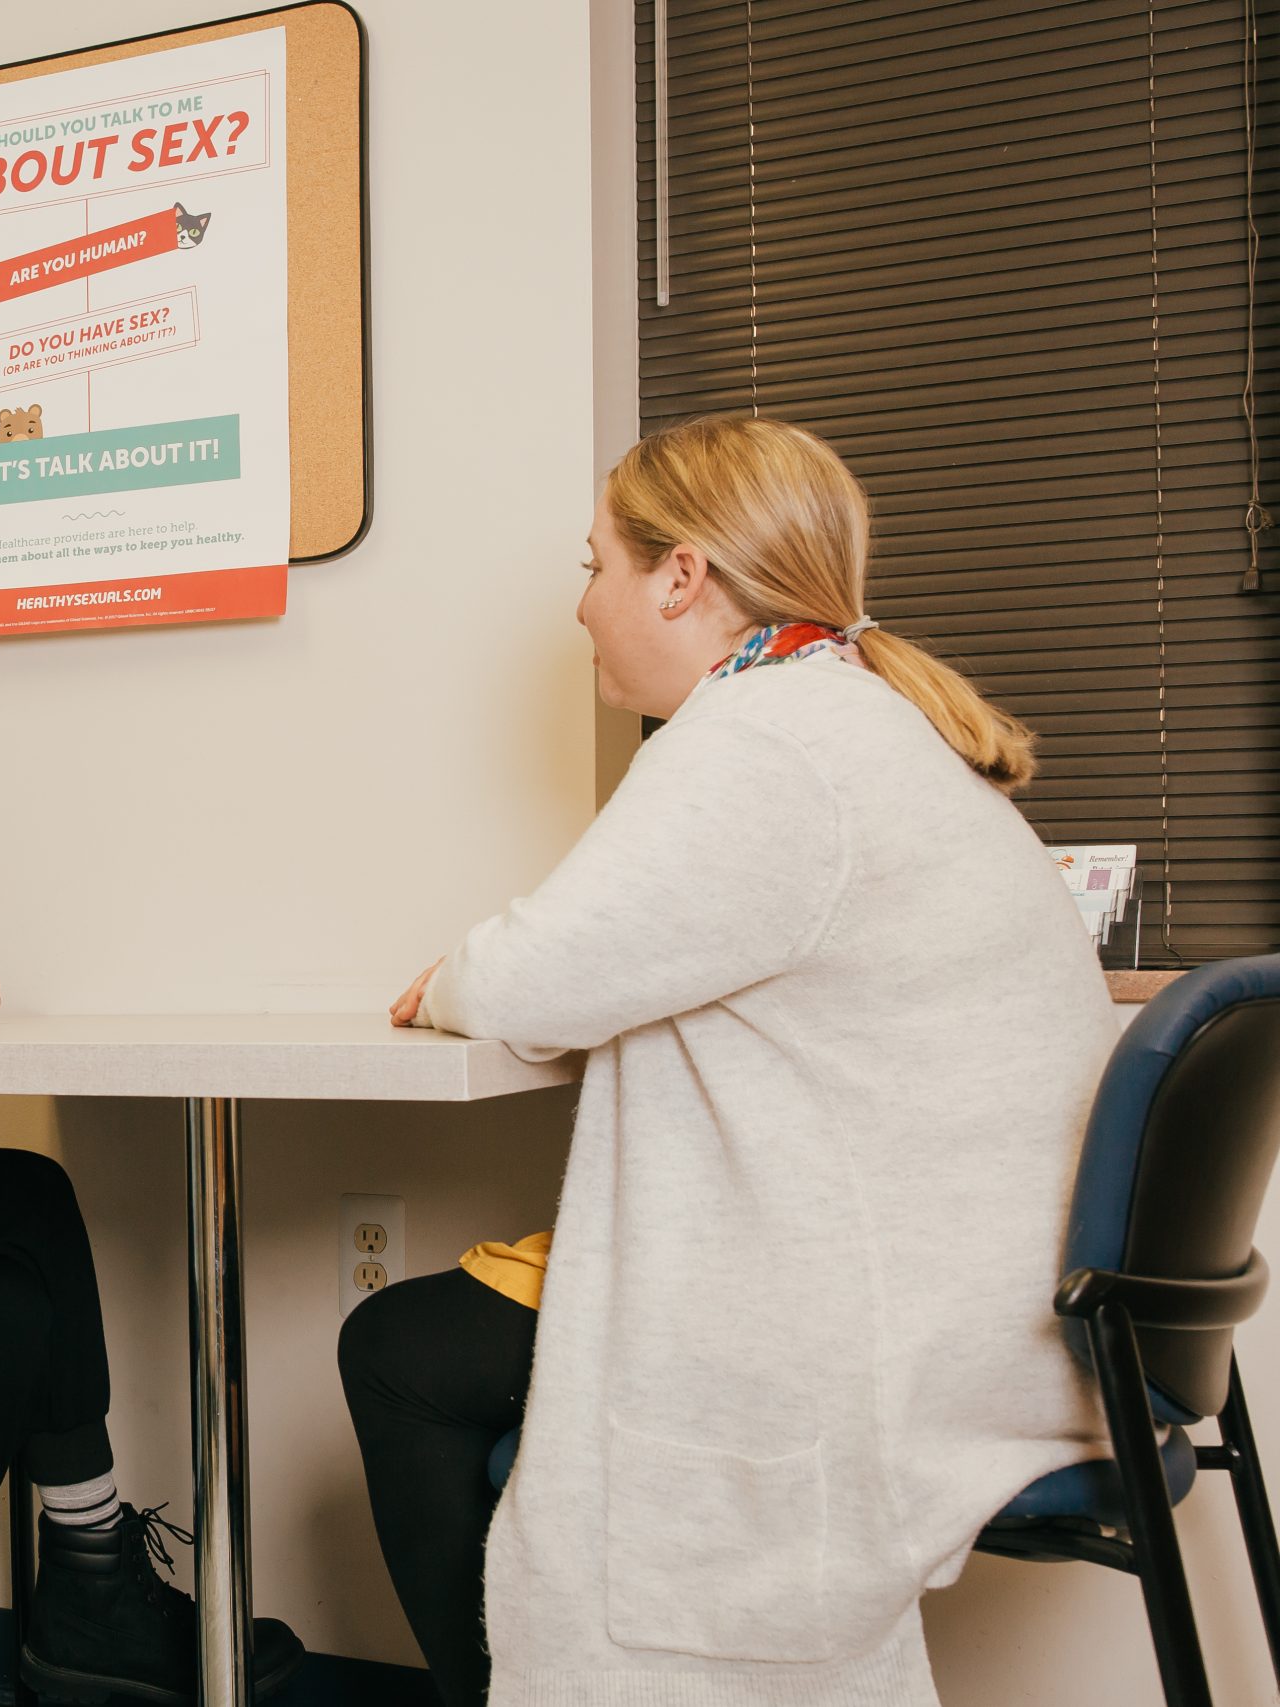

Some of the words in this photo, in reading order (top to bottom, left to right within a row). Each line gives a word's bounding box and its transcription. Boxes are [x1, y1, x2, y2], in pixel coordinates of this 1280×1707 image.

[60, 116, 96, 135] YOU
[100, 107, 144, 129] TALK
[147, 102, 172, 119] TO
[177, 96, 203, 114] ME
[128, 111, 250, 173] SEX?
[10, 262, 40, 286] ARE
[43, 252, 76, 276] YOU
[79, 231, 147, 264] HUMAN?
[3, 364, 21, 377] (OR
[23, 358, 42, 372] ARE
[44, 353, 66, 367] YOU
[67, 341, 118, 362] THINKING
[119, 333, 155, 350] ABOUT
[157, 325, 177, 342] IT?)
[9, 340, 35, 360] DO
[38, 331, 75, 353] YOU
[79, 319, 125, 343] HAVE
[128, 308, 170, 331] SEX?
[35, 453, 93, 478] TALK
[98, 443, 182, 472] ABOUT
[188, 439, 219, 462] IT!
[21, 549, 54, 563] about
[56, 547, 70, 559] all
[72, 545, 91, 558] the
[93, 543, 123, 558] ways
[125, 541, 137, 552] to
[140, 538, 168, 553] keep
[170, 536, 193, 550] you
[196, 531, 245, 548] healthy.
[53, 530, 106, 547] providers
[108, 528, 126, 539] are
[128, 524, 154, 537] here
[156, 523, 168, 535] to
[170, 520, 198, 537] help.
[17, 587, 162, 610] HEALTHYSEXUALS.COM
[1089, 854, 1129, 863] Remember!
